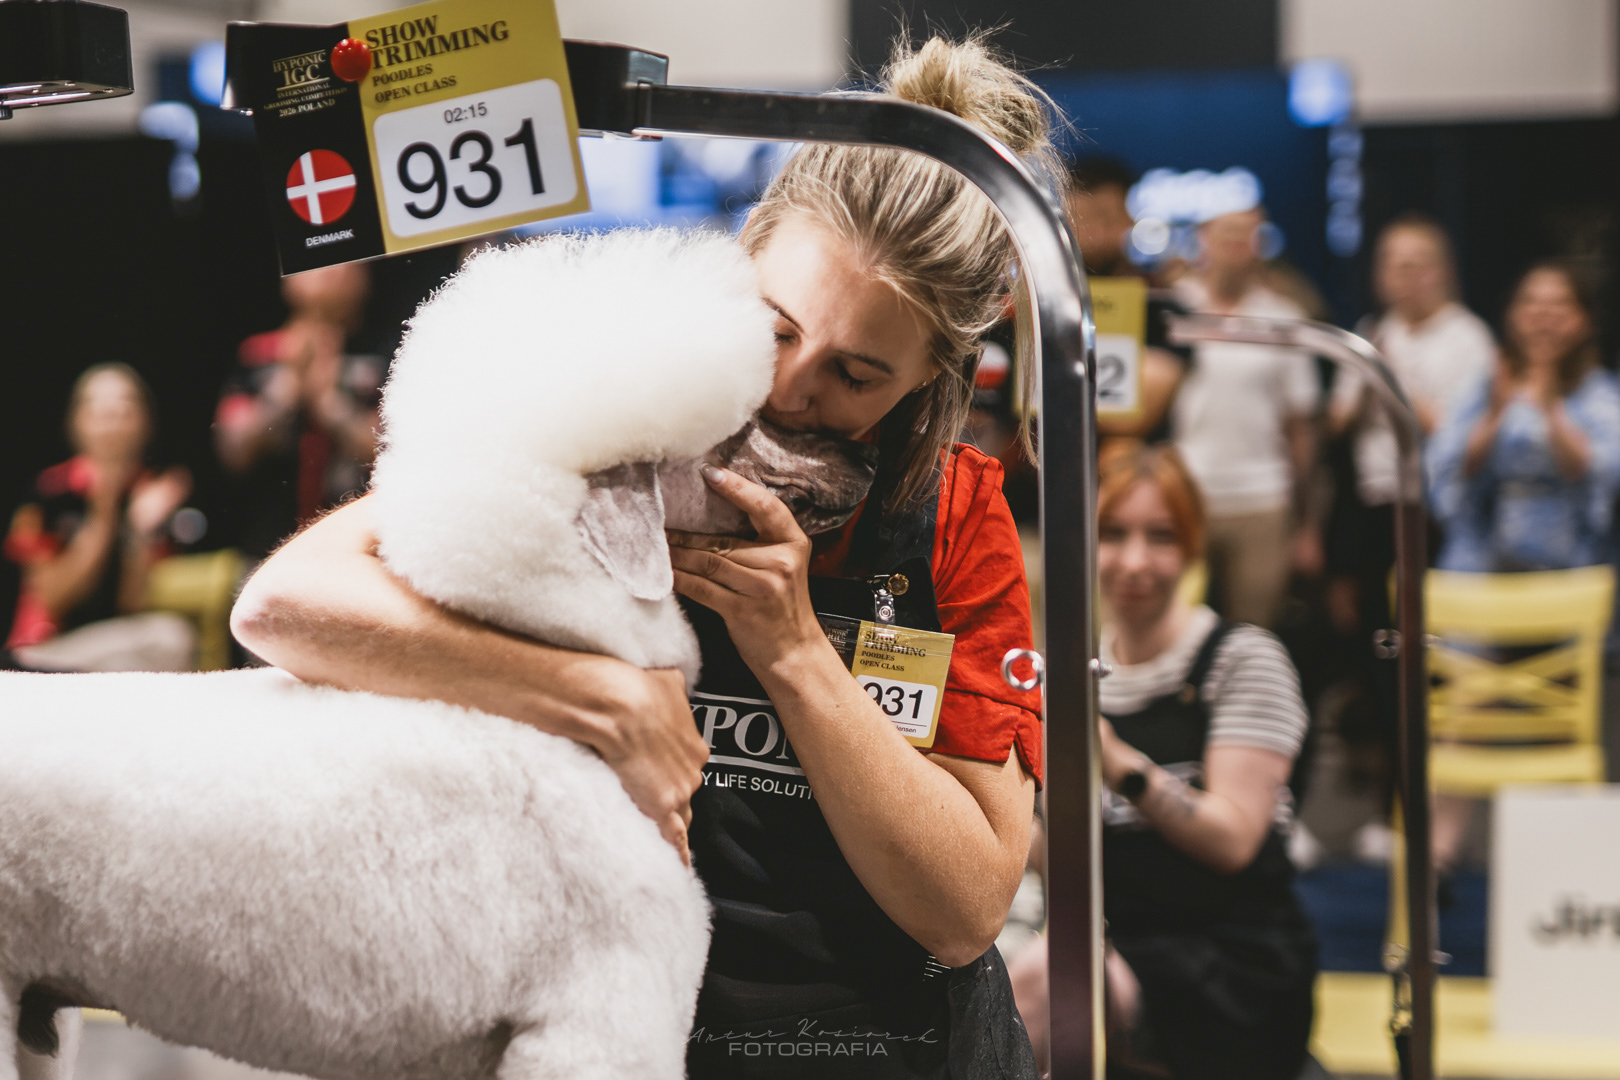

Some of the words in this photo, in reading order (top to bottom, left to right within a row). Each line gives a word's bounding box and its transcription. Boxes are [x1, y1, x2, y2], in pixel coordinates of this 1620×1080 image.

[365, 15, 438, 49] SHOW
[370, 20, 509, 69] TRIMMING
[273, 52, 326, 73] HYPONIC
[283, 64, 320, 86] IGC
[372, 63, 433, 87] POODLES
[277, 82, 330, 98] INTERNATIONAL
[374, 85, 411, 104] OPEN
[414, 75, 457, 95] CLASS
[298, 98, 336, 113] POLAND
[444, 102, 488, 124] 02:15
[397, 117, 546, 220] 931
[305, 229, 354, 247] DENMARK
[859, 659, 880, 668] OPEN
[881, 662, 905, 671] CLASS
[861, 650, 895, 661] POODLES
[863, 682, 923, 719] 931
[716, 772, 747, 789] LIFE
